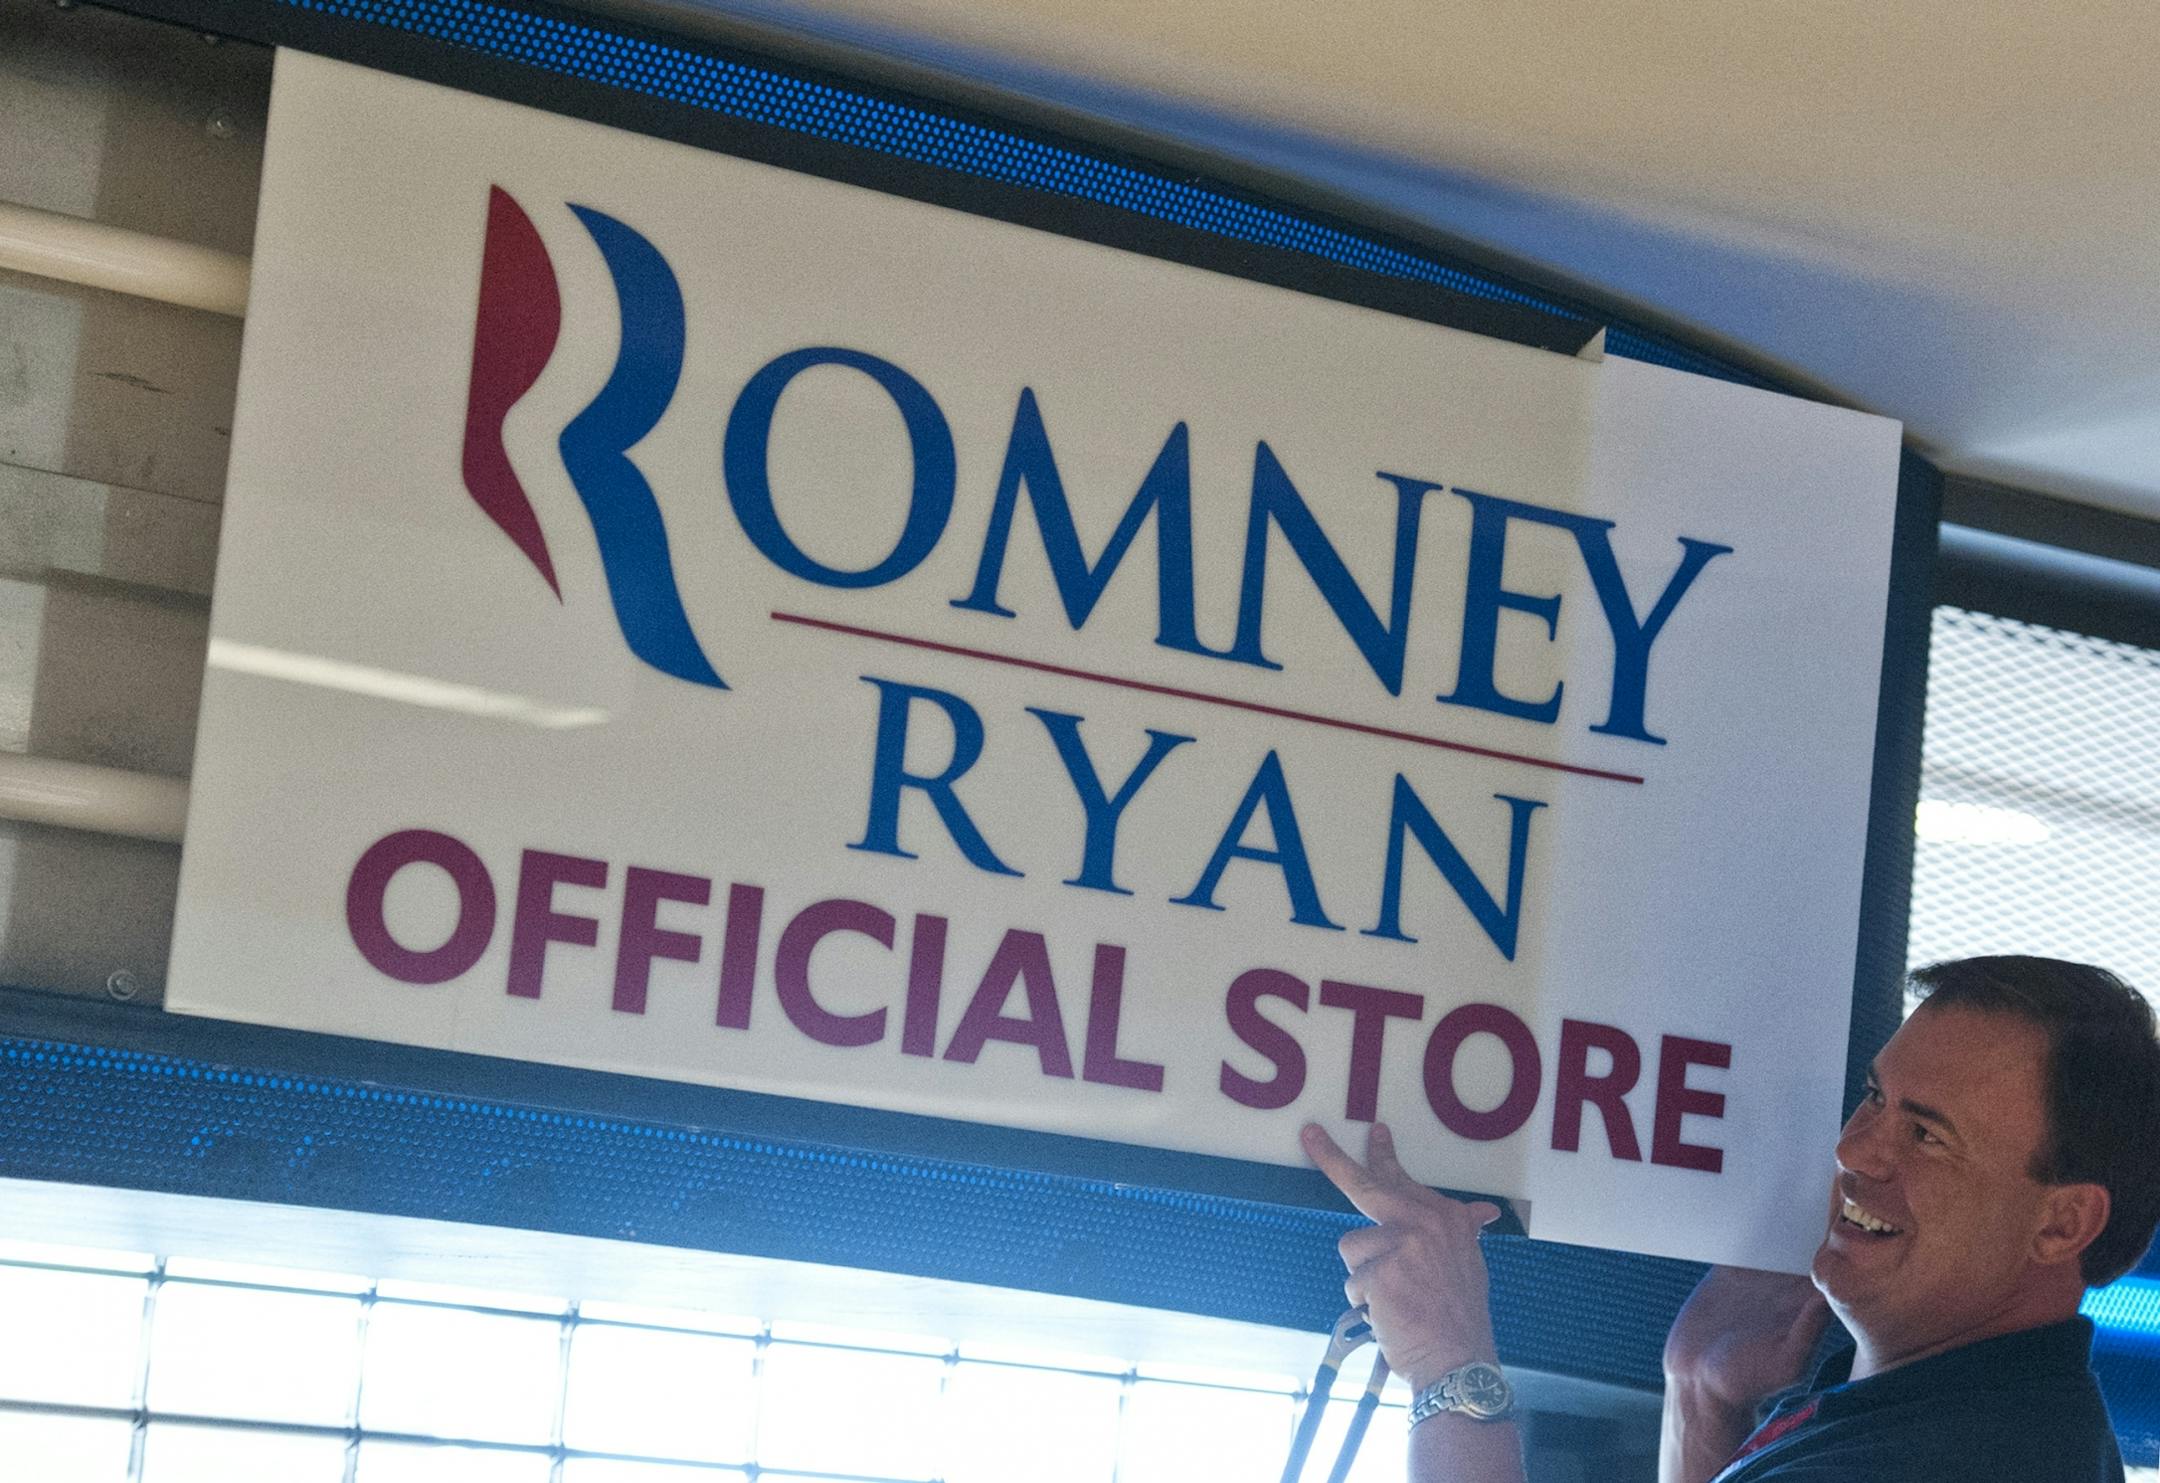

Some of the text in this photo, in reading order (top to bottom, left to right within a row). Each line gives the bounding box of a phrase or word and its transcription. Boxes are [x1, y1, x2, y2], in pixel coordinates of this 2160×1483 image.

[461, 184, 1734, 748] ROMNEY
[845, 676, 1550, 963] RYAN
[346, 829, 1732, 1174] OFFICIAL STORE
